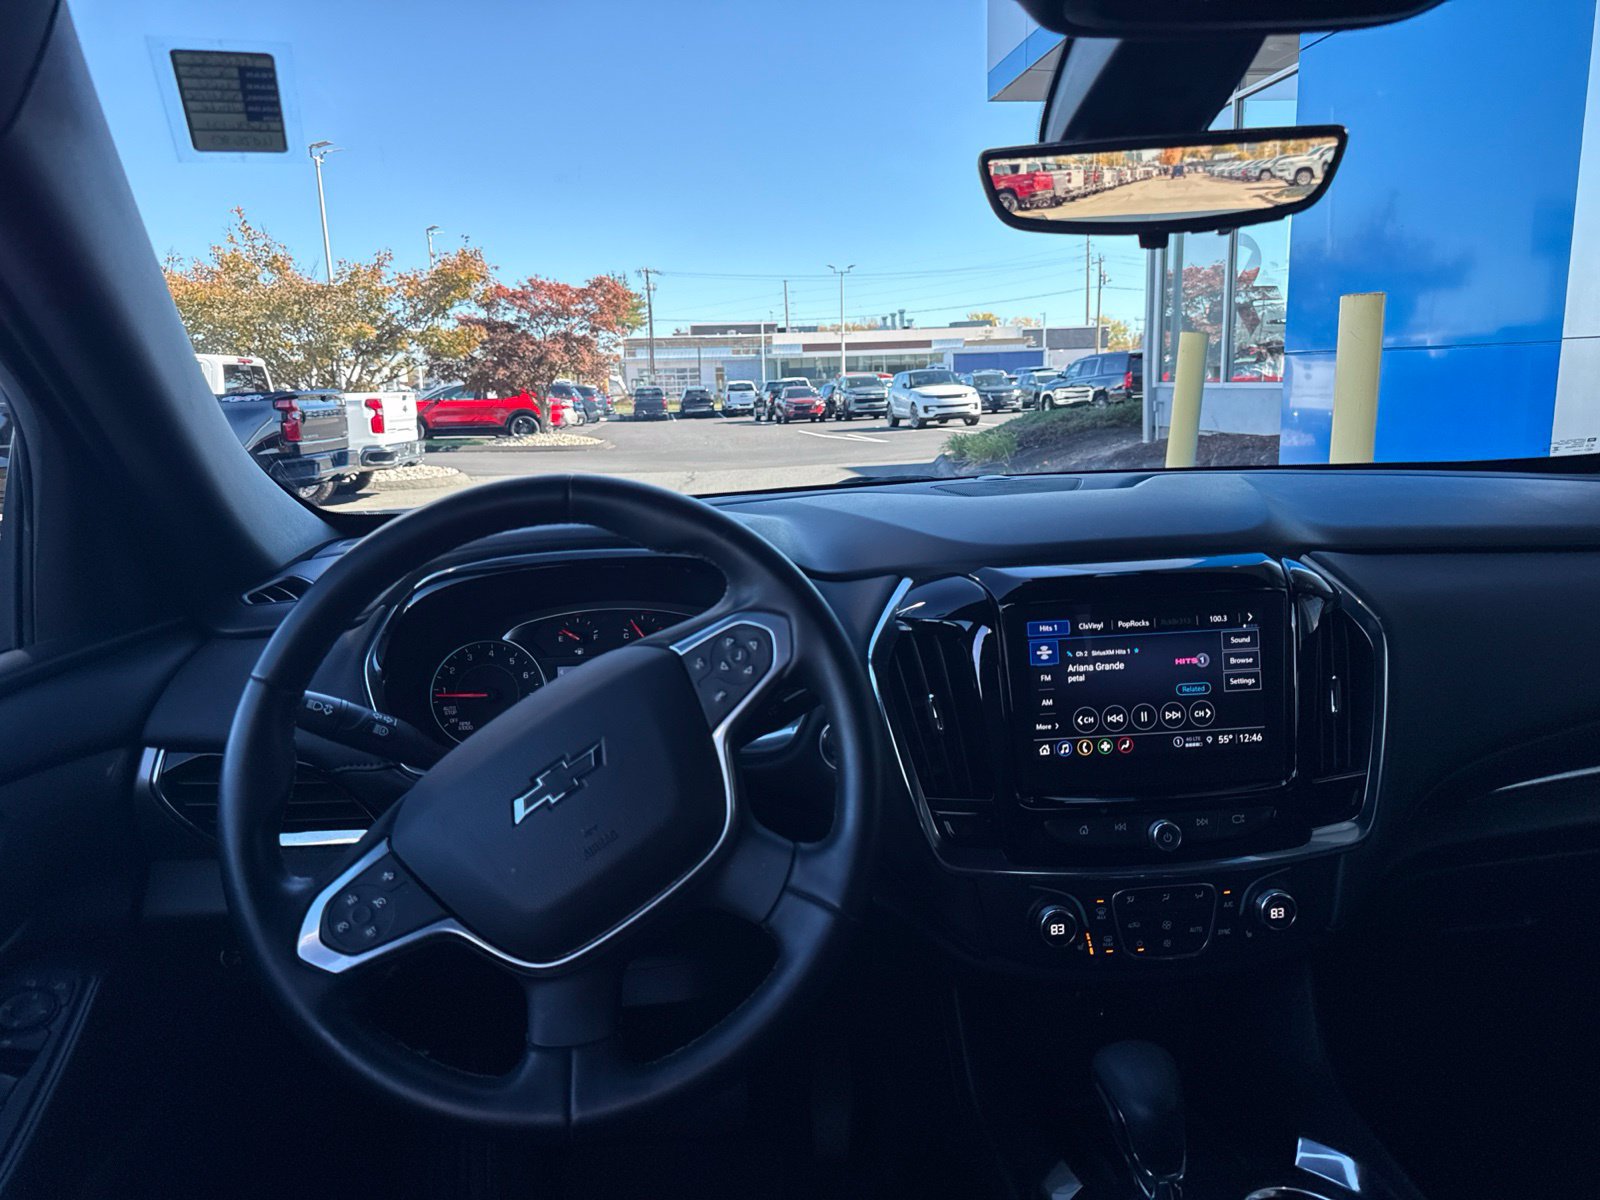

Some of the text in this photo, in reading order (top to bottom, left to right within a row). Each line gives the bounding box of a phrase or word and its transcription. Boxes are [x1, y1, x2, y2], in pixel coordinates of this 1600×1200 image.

[1209, 615, 1228, 623] 100.3
[1039, 624, 1053, 632] Hits
[1078, 621, 1104, 631] ClsVinyl
[1118, 620, 1150, 629] PopRocks
[1230, 635, 1251, 644] Sound
[1091, 649, 1114, 657] SiriusXM
[509, 657, 515, 665] 5
[1229, 656, 1253, 665] Browse
[1067, 661, 1125, 673] Ariana Grande
[523, 671, 529, 679] 6
[1067, 674, 1085, 684] petal
[1229, 677, 1255, 686] Settings
[1182, 685, 1206, 693] Related
[1036, 723, 1052, 731] More
[1239, 733, 1263, 743] 12:46
[1270, 907, 1285, 919] 83
[1050, 924, 1065, 935] 83
